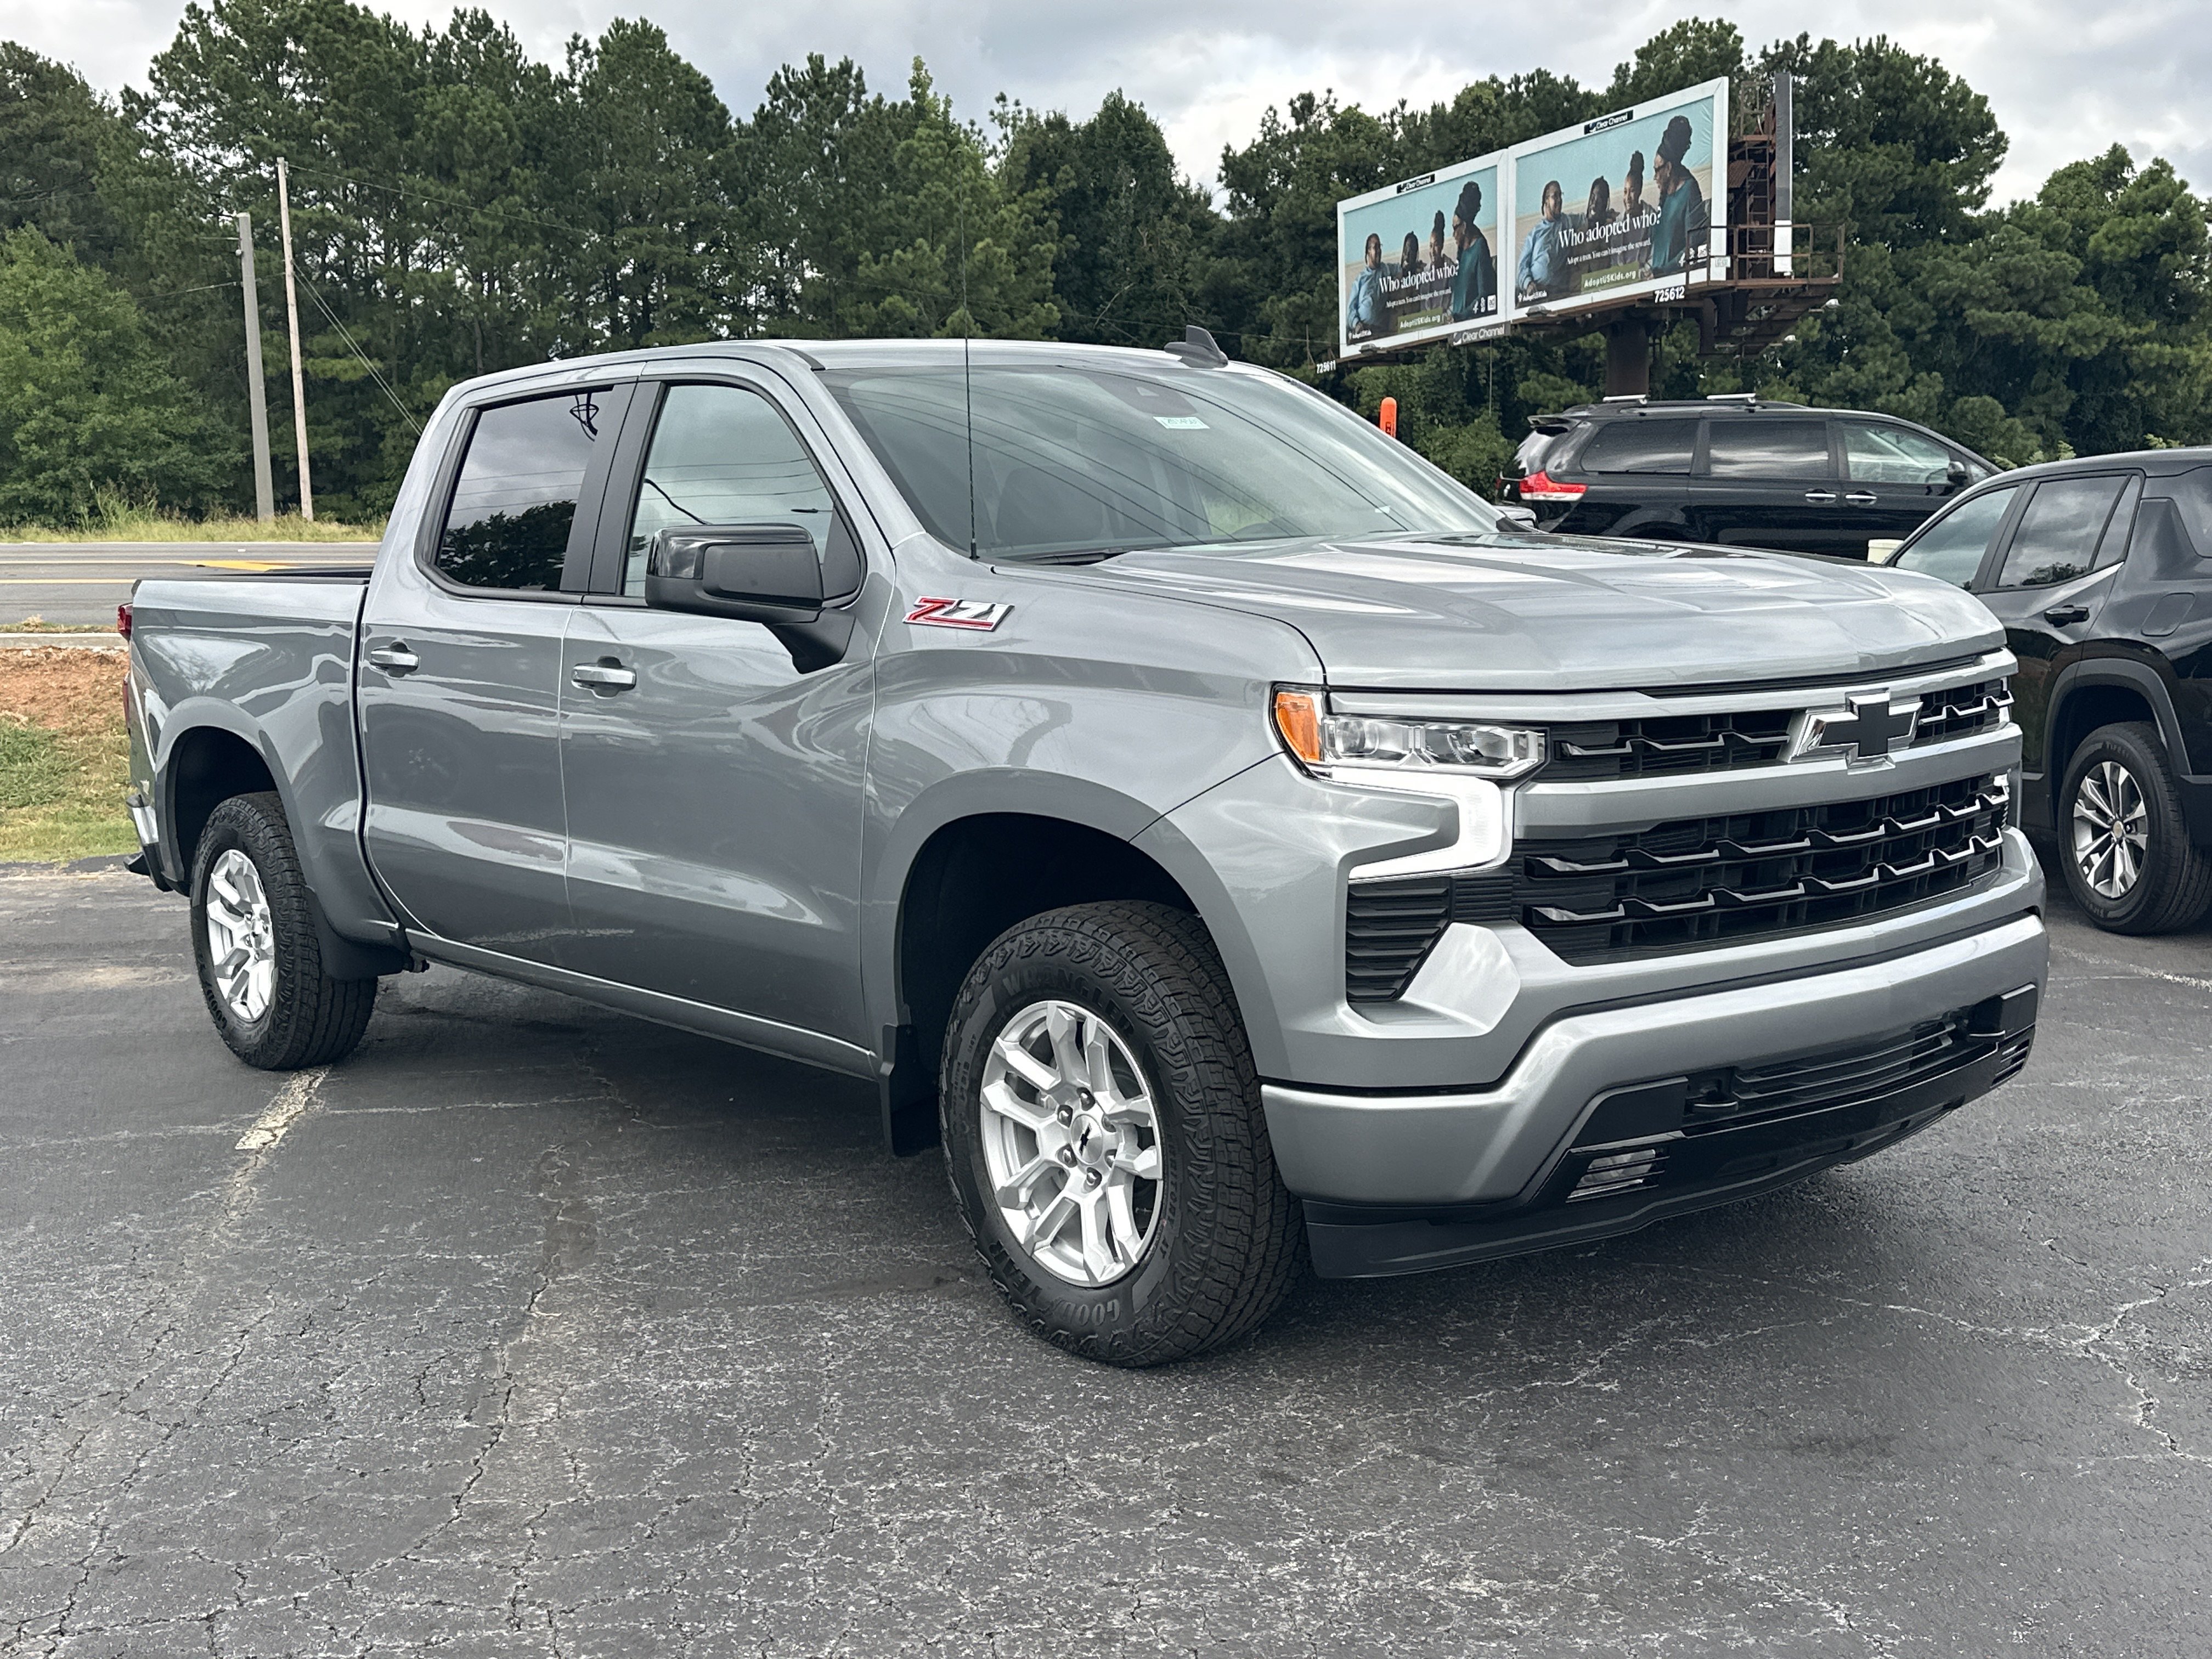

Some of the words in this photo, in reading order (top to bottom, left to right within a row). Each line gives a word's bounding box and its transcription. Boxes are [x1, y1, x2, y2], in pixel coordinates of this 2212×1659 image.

[1558, 228, 1585, 248] Who
[1585, 213, 1630, 242] adopted
[1632, 206, 1662, 229] who?
[1379, 276, 1400, 293] Who
[1400, 264, 1435, 290] adopted
[1436, 259, 1459, 279] who?
[1584, 270, 1637, 287] AdoptUSKids.org
[1654, 286, 1685, 302] 725612
[1462, 331, 1478, 342] Clear
[1479, 323, 1505, 339] Channel
[902, 596, 1015, 632] Z71
[1001, 965, 1135, 1036] WRANGLER
